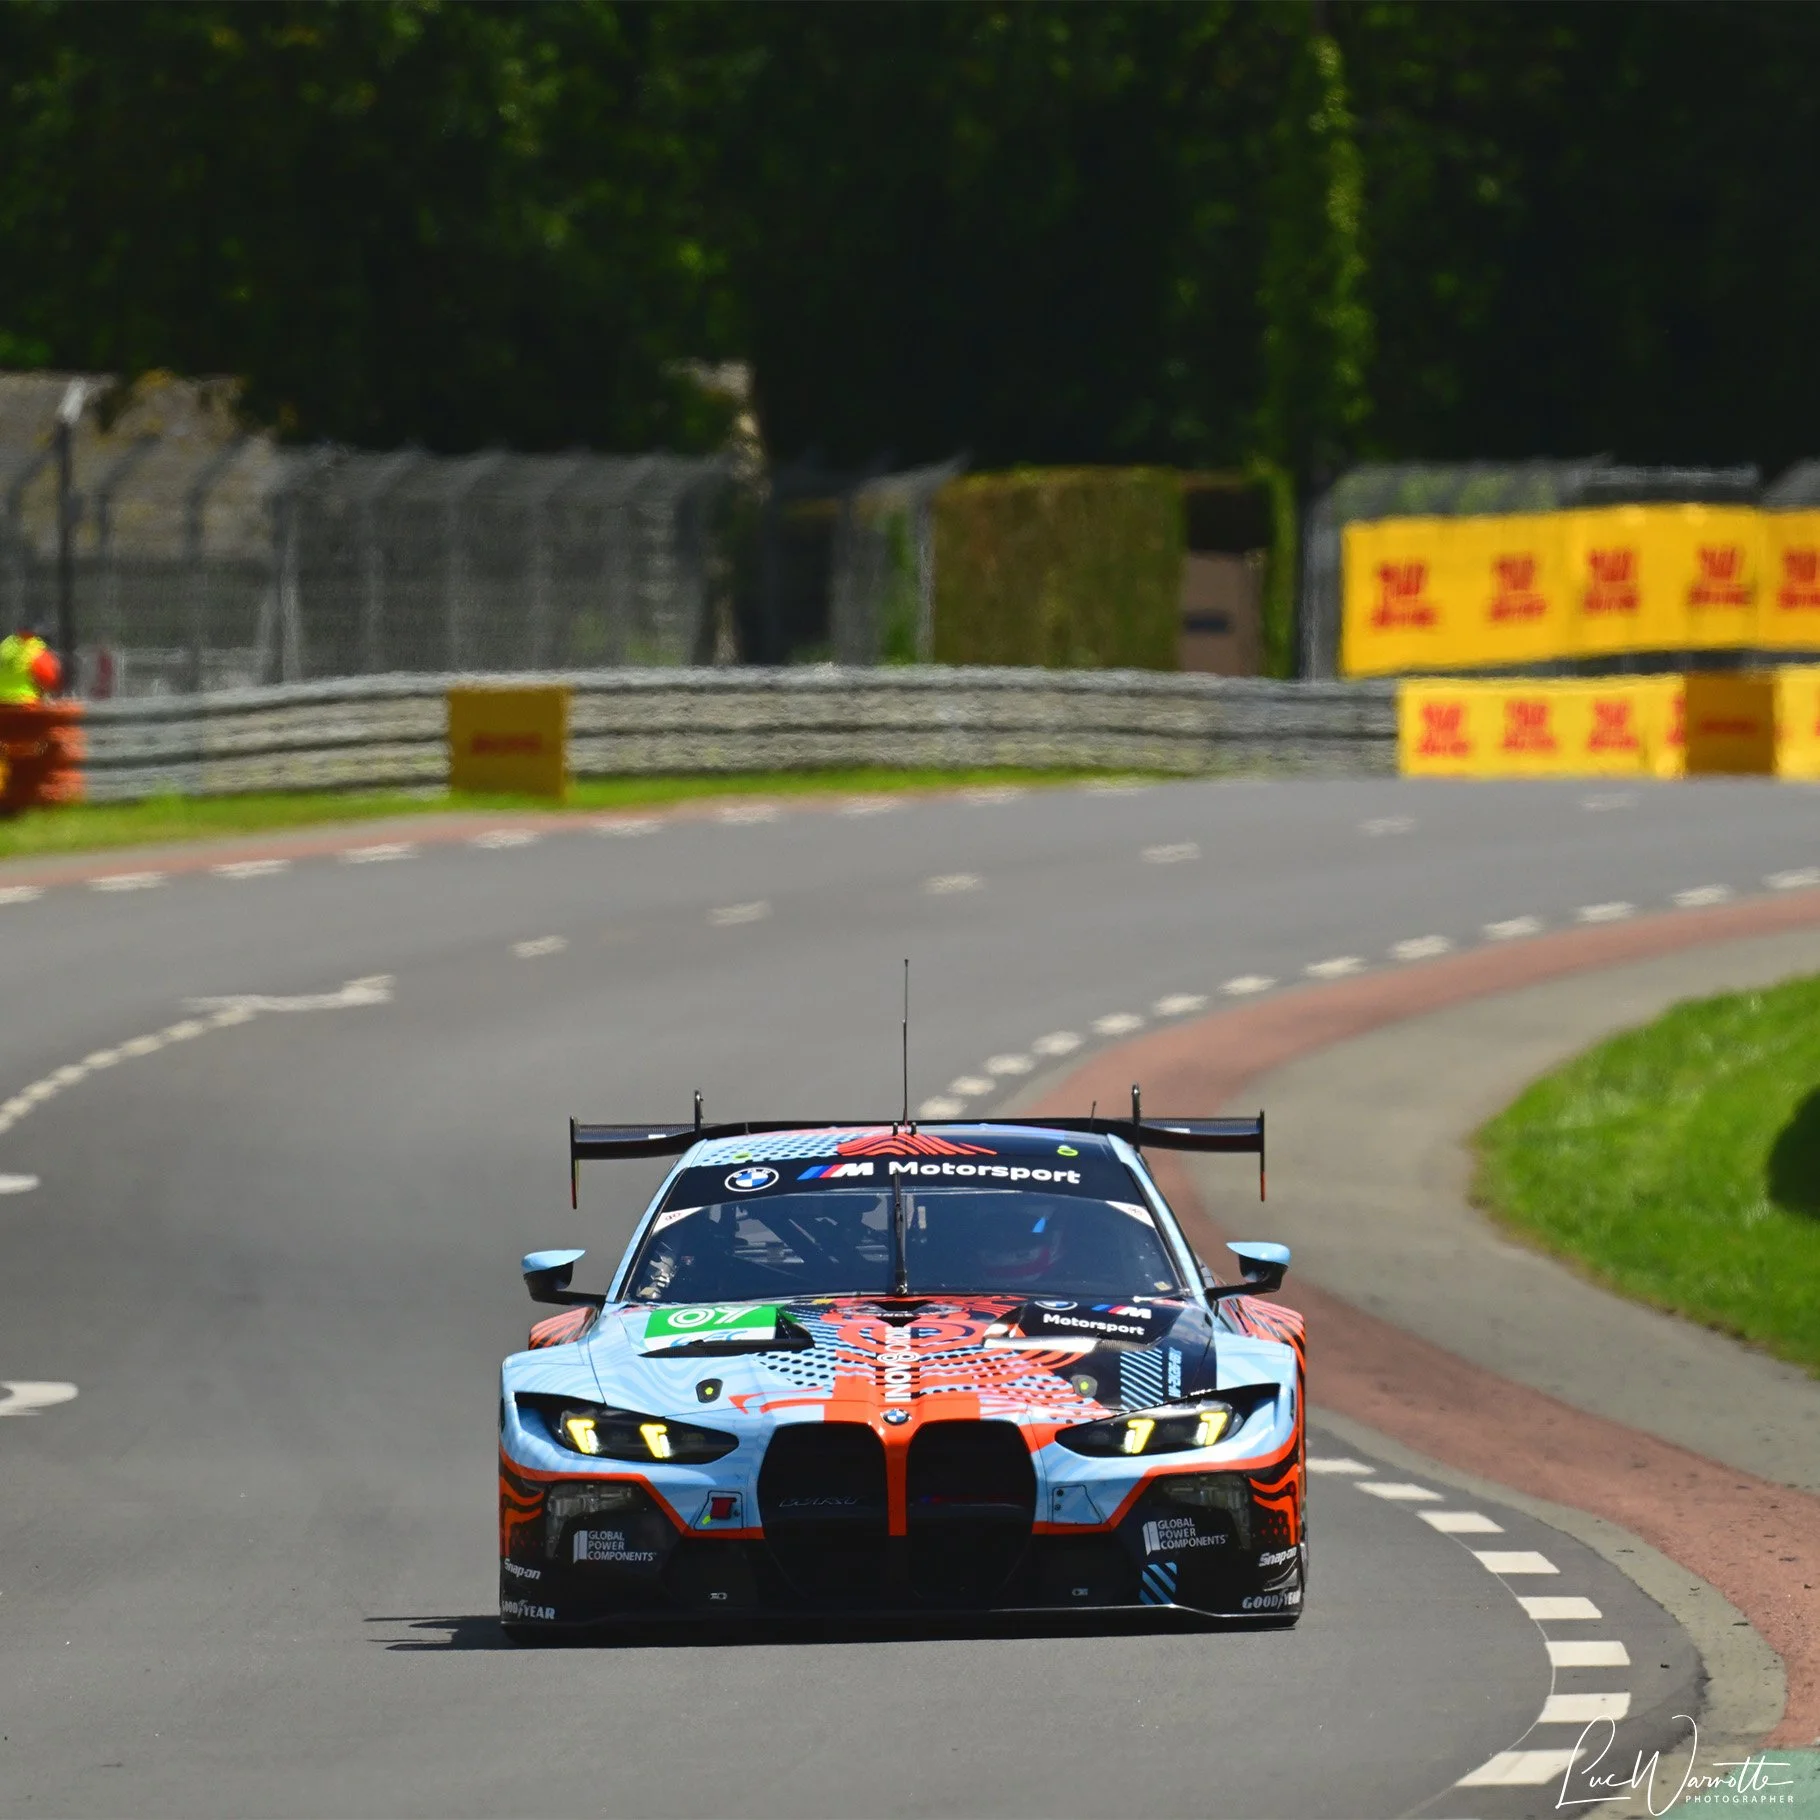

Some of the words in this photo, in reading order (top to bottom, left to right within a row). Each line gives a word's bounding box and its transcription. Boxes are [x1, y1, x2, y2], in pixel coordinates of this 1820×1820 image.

[889, 1161, 1081, 1184] Motorsport
[1043, 1313, 1145, 1336] Motorsport
[1157, 1517, 1195, 1530] GLOBAL
[588, 1530, 625, 1541] GLOBAL
[1159, 1528, 1196, 1539] POWER
[588, 1541, 625, 1551] POWER
[1160, 1535, 1226, 1550] COMPONENTS
[587, 1551, 654, 1562] COMPONENTS
[1258, 1546, 1298, 1567] Snap-on
[504, 1557, 541, 1580] Snap-on
[1242, 1589, 1301, 1610] GOODYEAR
